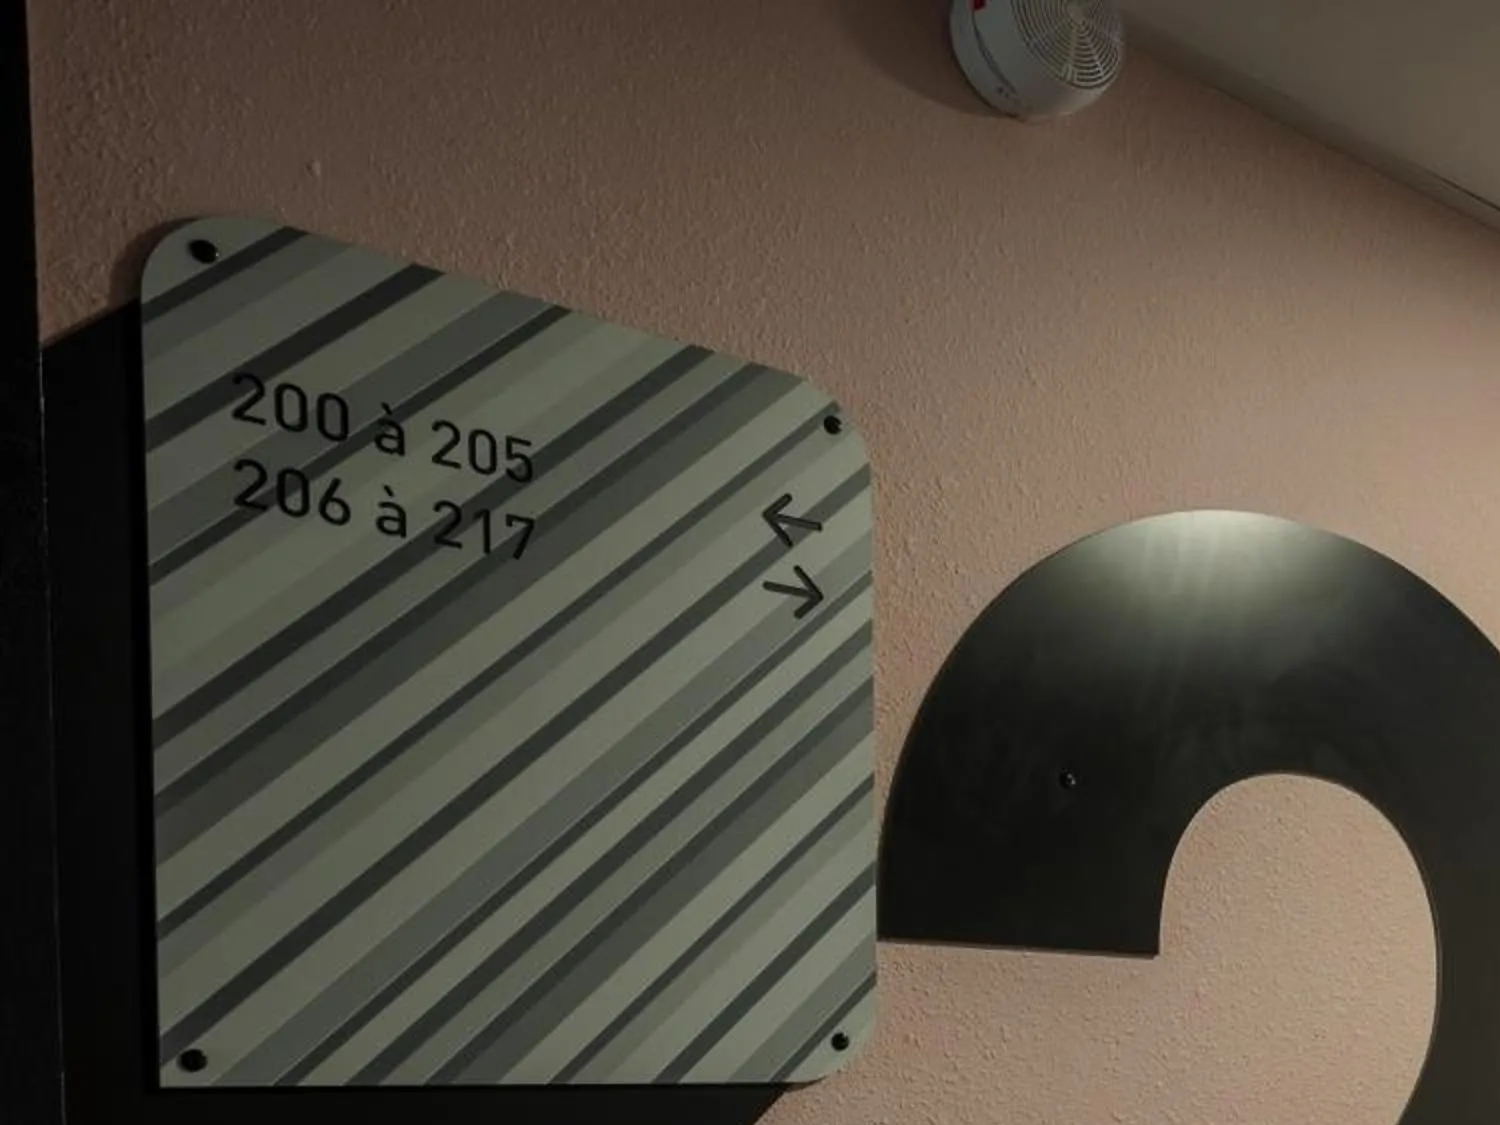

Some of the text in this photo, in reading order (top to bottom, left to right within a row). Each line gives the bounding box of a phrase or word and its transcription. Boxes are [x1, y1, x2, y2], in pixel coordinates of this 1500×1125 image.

[233, 373, 534, 484] 200 à 205
[233, 458, 536, 560] 206 à 217
